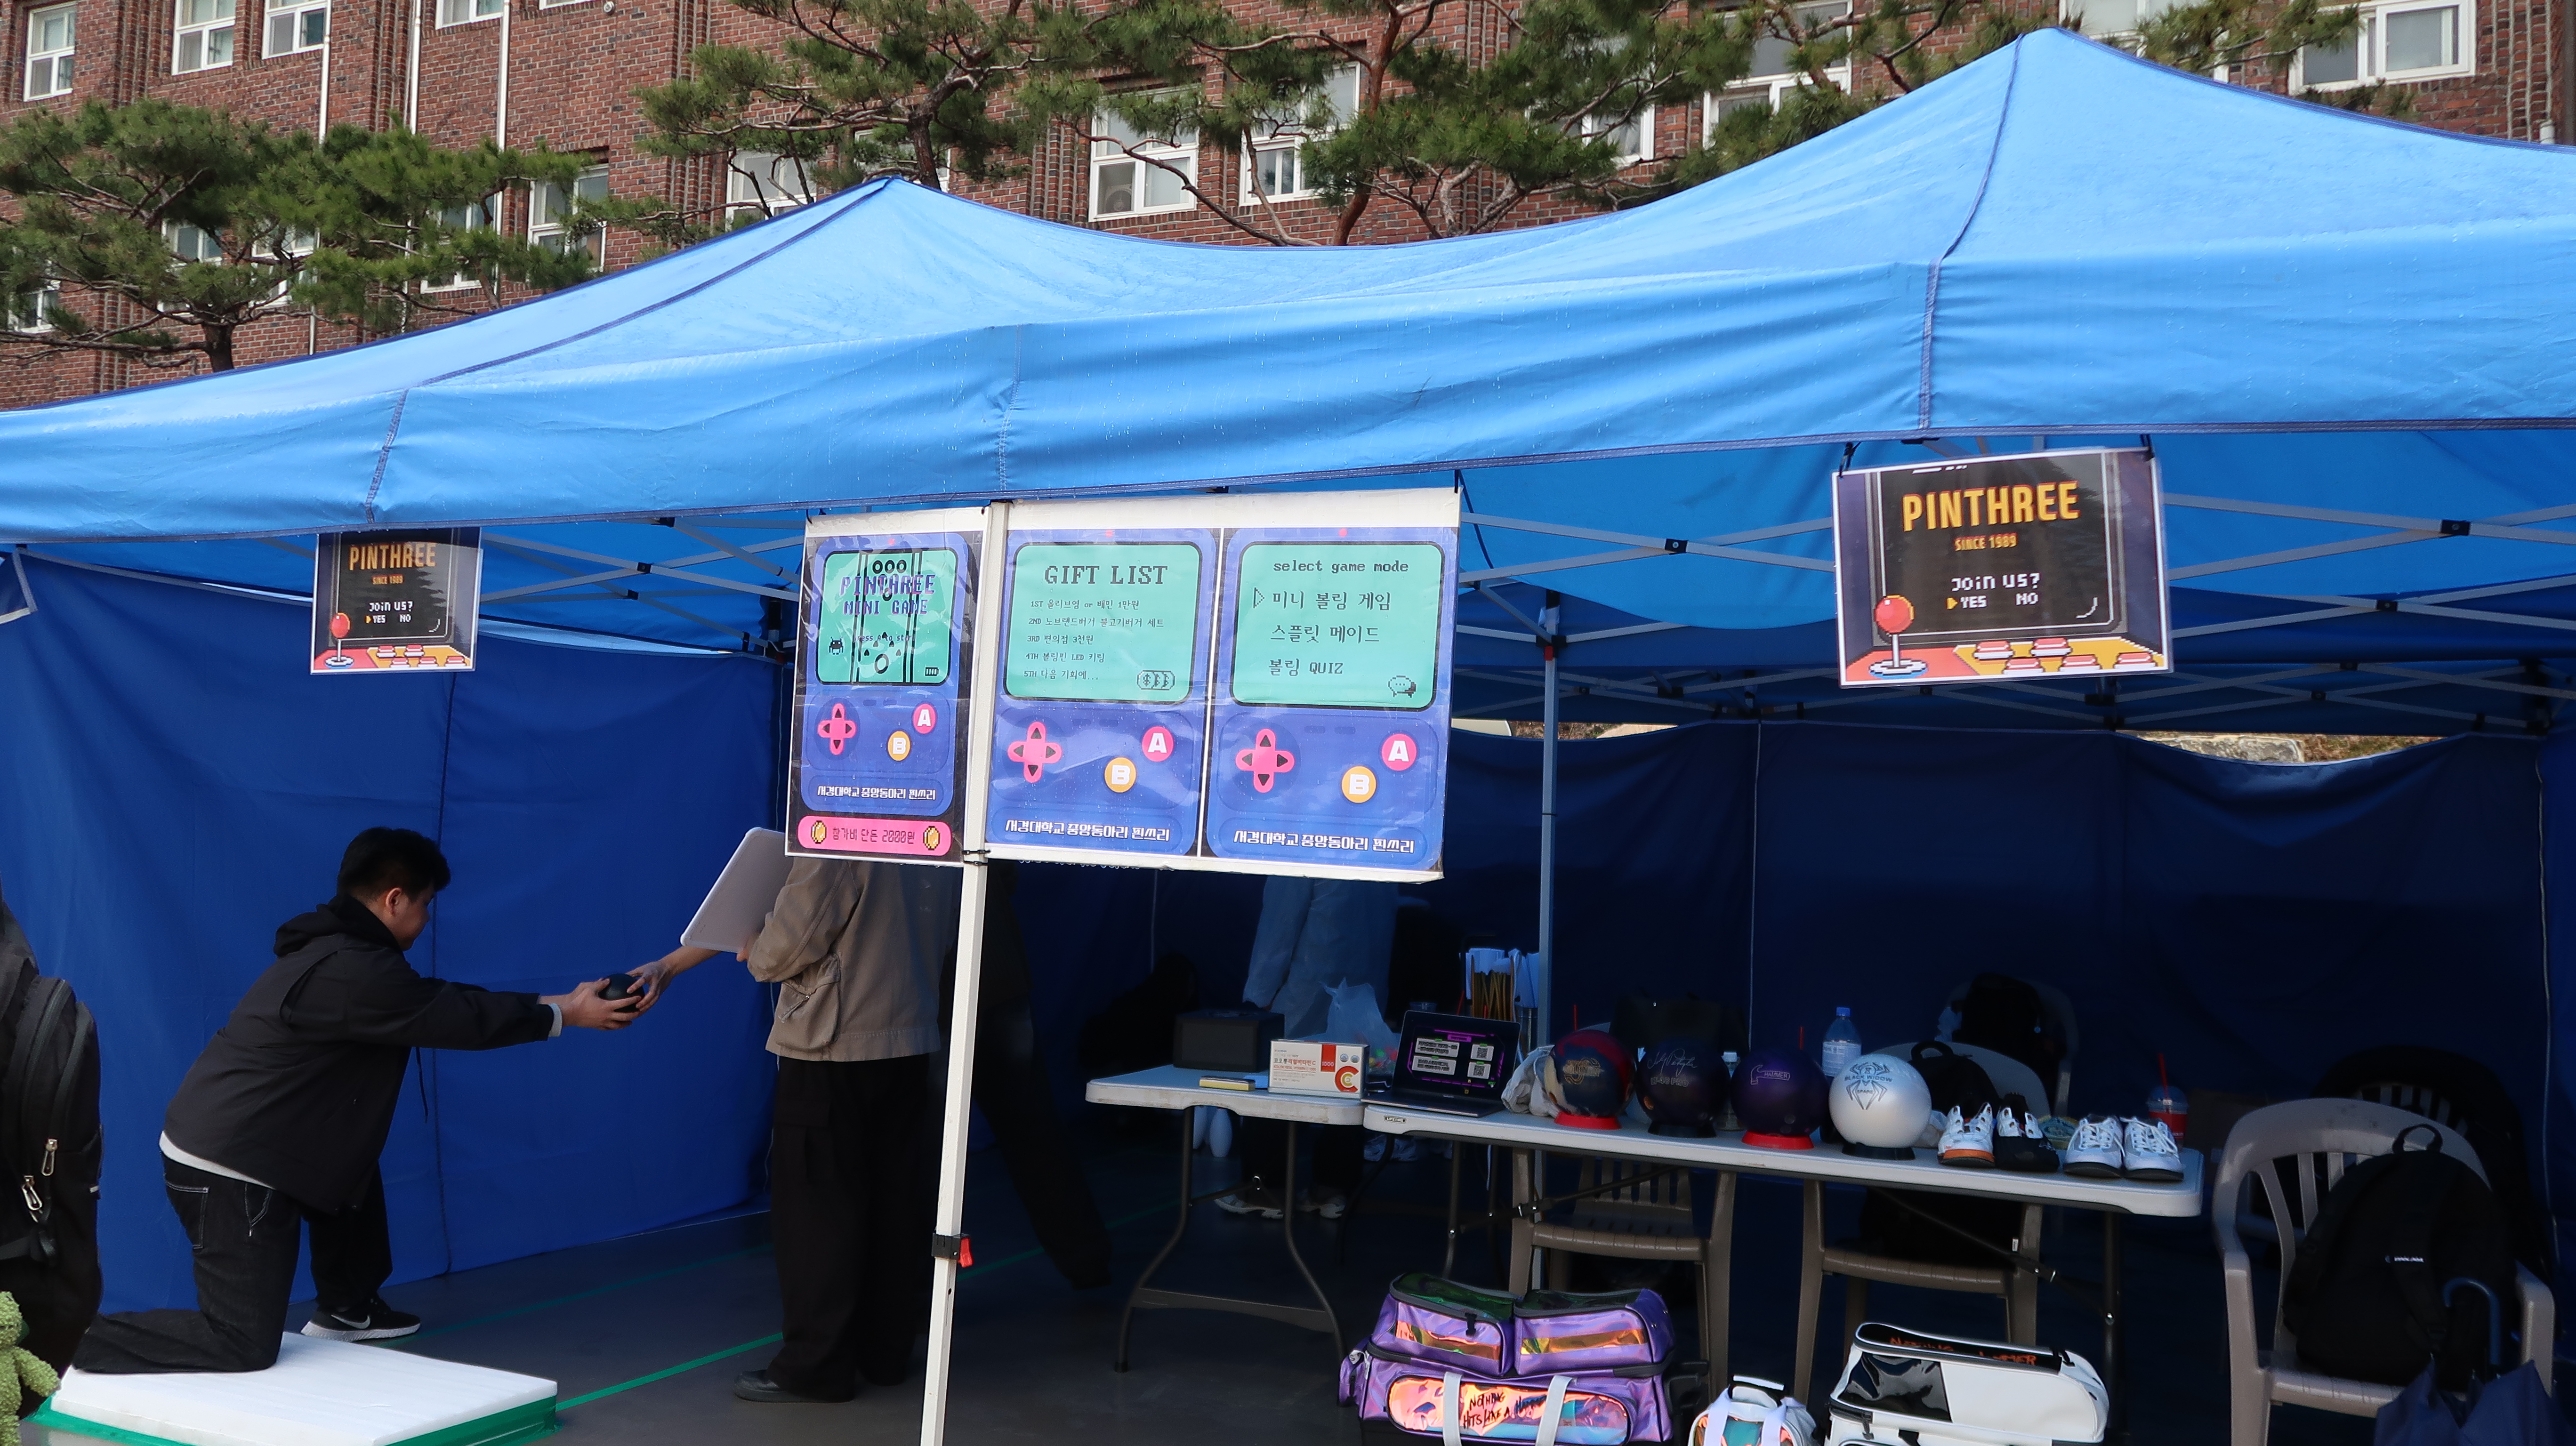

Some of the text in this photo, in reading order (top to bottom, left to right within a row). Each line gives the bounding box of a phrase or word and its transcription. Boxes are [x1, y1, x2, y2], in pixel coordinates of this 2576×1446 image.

[1902, 480, 2081, 532] PINTHREE
[1955, 533, 2018, 551] SINCE 1989
[349, 542, 437, 570] PINTHREE
[1044, 565, 1168, 585] GIFT LIST
[1273, 560, 1409, 574] select game mode
[372, 575, 387, 585] SINCE
[840, 574, 936, 596] PINTHREE
[843, 599, 928, 615] MINI GAME
[1047, 599, 1080, 610] 올리브영
[1097, 600, 1113, 610] 배민
[1118, 600, 1139, 610] 1만원
[1272, 591, 1391, 611] 미니 볼링 게임
[1960, 592, 2038, 609] YES NO
[372, 614, 411, 623] YES NO
[1045, 617, 1095, 627] 노브랜드버거
[1100, 618, 1143, 628] 불고기버거
[1147, 618, 1164, 628] 세트
[1044, 635, 1069, 644] 편의점
[1072, 635, 1094, 645] 3천원
[1270, 625, 1380, 643] 스플릿 메이드
[1042, 652, 1067, 662] 볼링핀
[1088, 653, 1105, 663] 키링
[1041, 669, 1057, 680] 다음
[1061, 670, 1099, 680] 기회에...
[1269, 659, 1344, 676] 볼링 QUIZ
[917, 709, 931, 727] A
[893, 737, 907, 755] B
[1148, 732, 1166, 753] A
[1388, 740, 1410, 763] A
[1112, 765, 1130, 784] B
[817, 786, 936, 801] 서경대학교 중앙동아리 핀쓰리
[1349, 774, 1370, 795] B
[882, 830, 915, 844] 2000원
[1005, 819, 1170, 842] 서경대학교 중앙동아리 핀쓰리
[1233, 830, 1414, 853] 서경대학교 중앙동아리 핀쓰리
